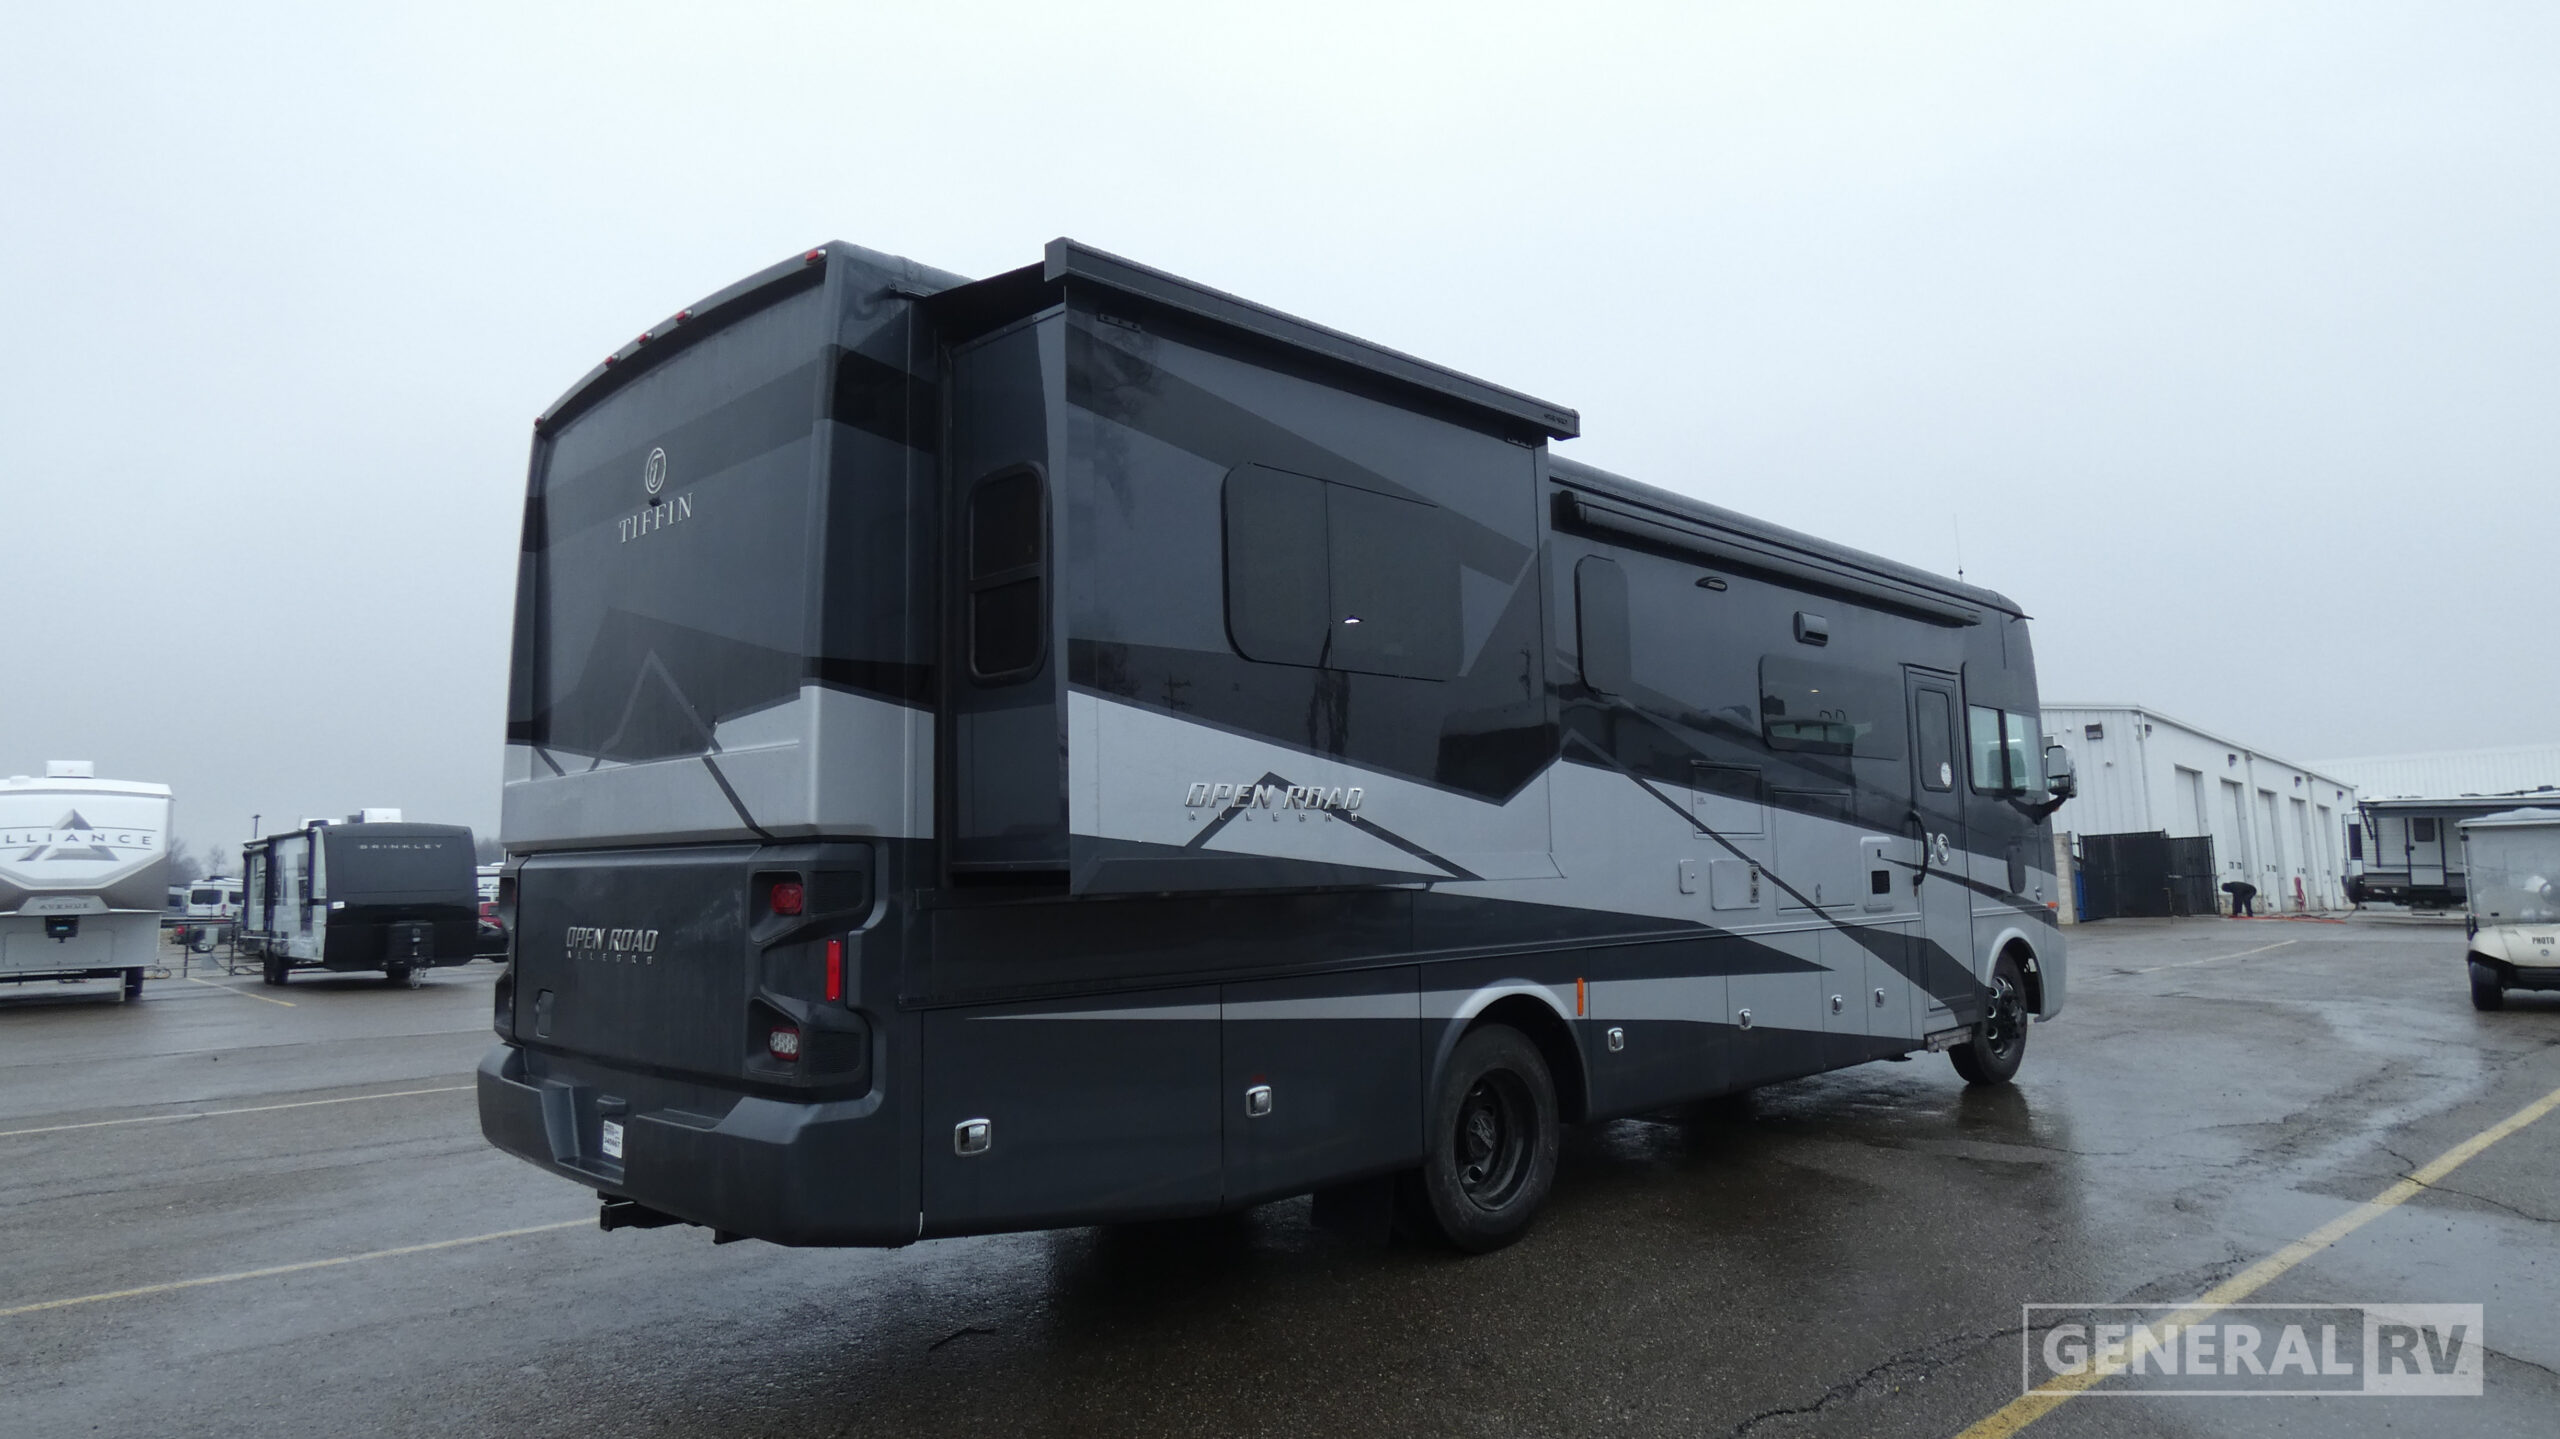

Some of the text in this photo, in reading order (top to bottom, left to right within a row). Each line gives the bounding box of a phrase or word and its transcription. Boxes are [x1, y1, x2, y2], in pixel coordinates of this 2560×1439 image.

[618, 492, 694, 543] TIFFIN
[1184, 782, 1364, 810] OPEN ROAD
[1188, 811, 1358, 823] ALLEGRO
[5, 833, 152, 846] LLIANCE
[566, 926, 658, 953] OPEN ROAD
[2531, 936, 2555, 945] PHOTO
[567, 950, 653, 964] ALLEGRO
